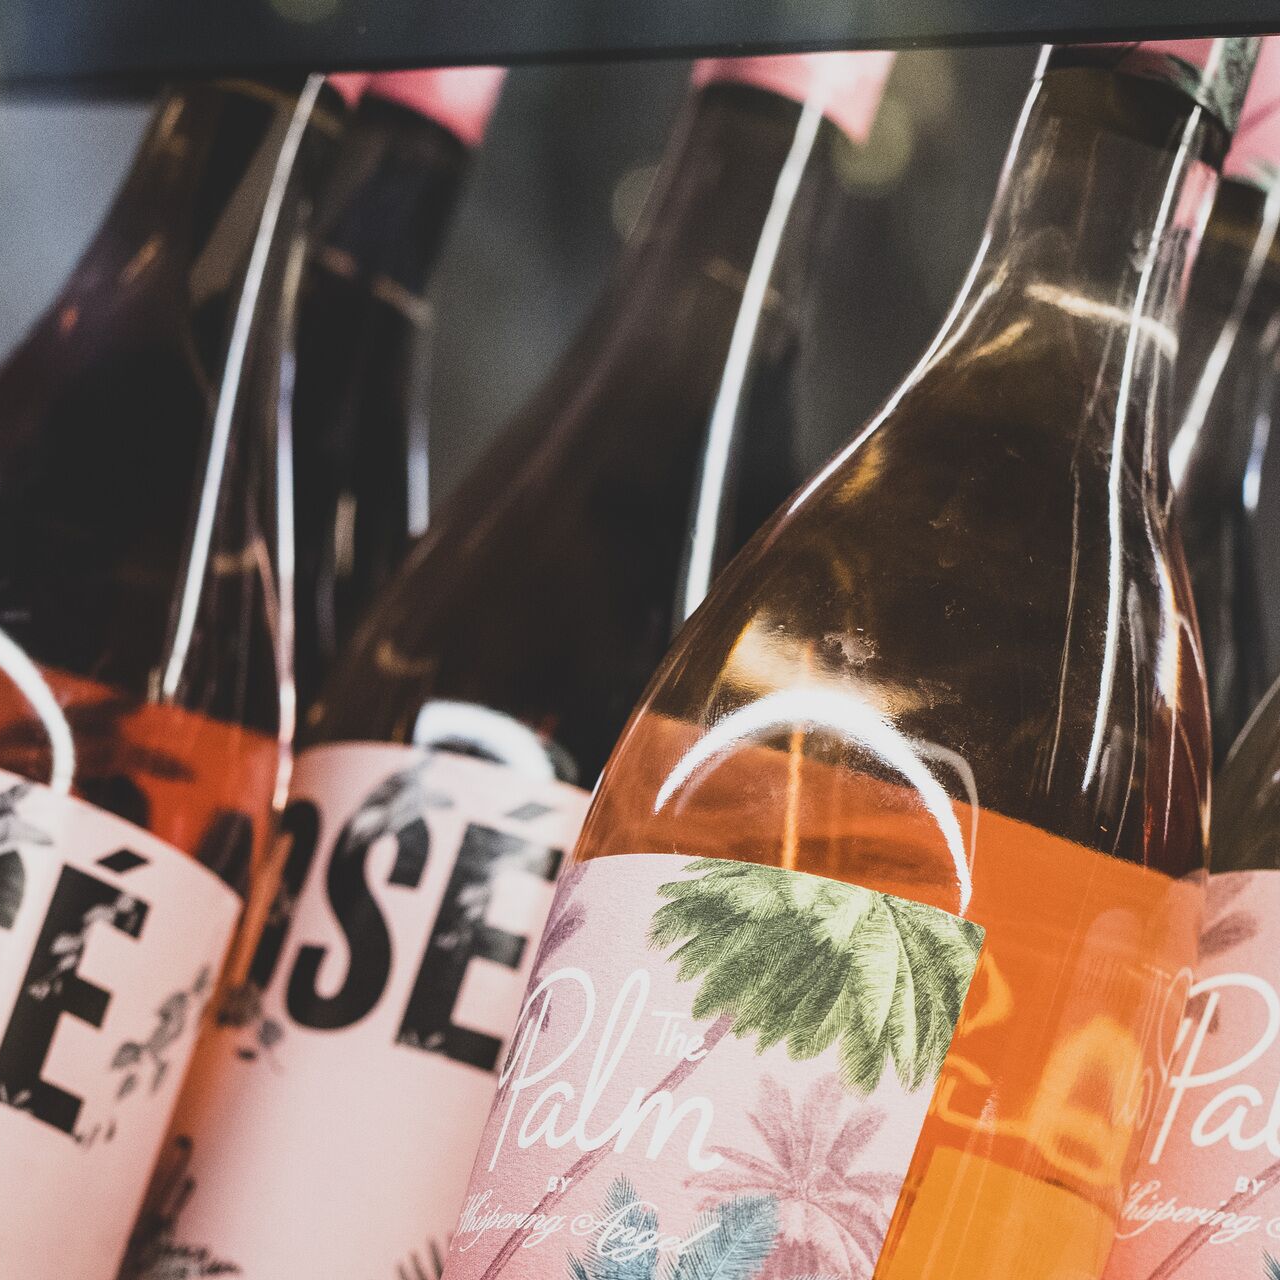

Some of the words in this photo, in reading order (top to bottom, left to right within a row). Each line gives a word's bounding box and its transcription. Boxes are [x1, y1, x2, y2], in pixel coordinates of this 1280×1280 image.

[650, 1006, 708, 1064] The
[489, 966, 722, 1173] Palm
[546, 1175, 572, 1193] BY
[1234, 1175, 1267, 1195] BY
